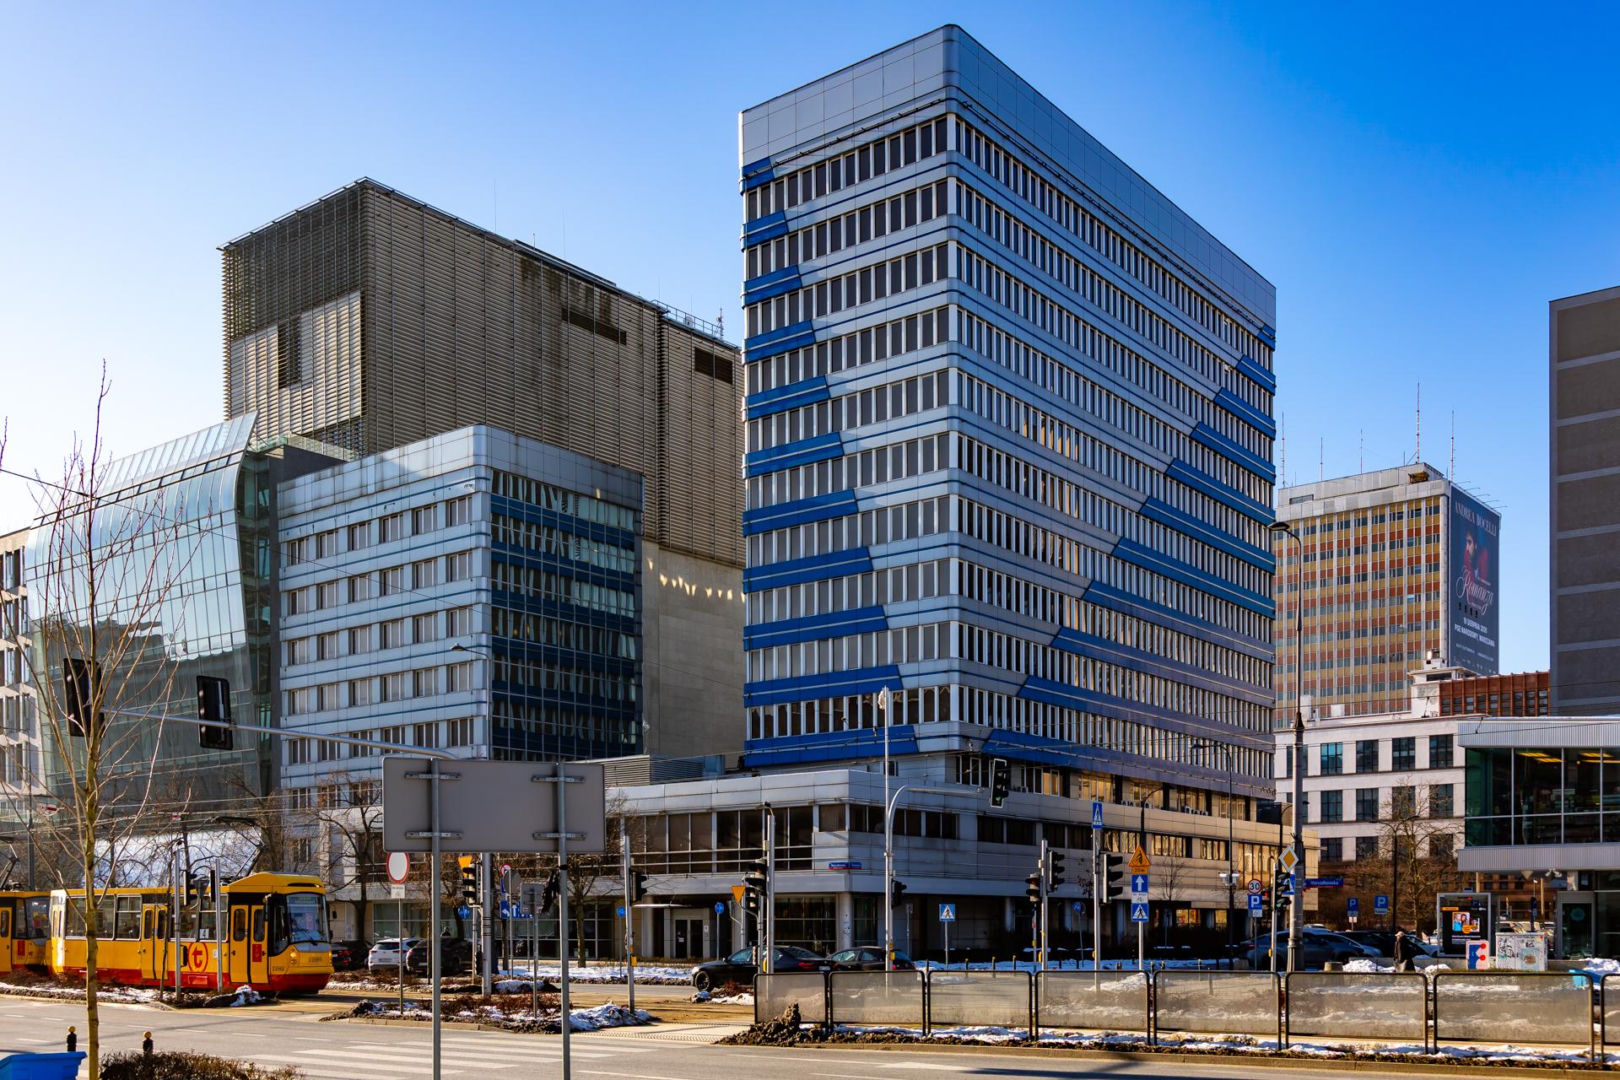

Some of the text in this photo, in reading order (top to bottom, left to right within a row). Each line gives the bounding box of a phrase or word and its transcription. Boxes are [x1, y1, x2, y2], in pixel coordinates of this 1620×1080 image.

[1455, 500, 1496, 537] ANDREA BOCELLI
[1250, 882, 1260, 891] 30
[1251, 895, 1260, 908] P
[1349, 898, 1356, 907] P
[1377, 897, 1386, 907] P
